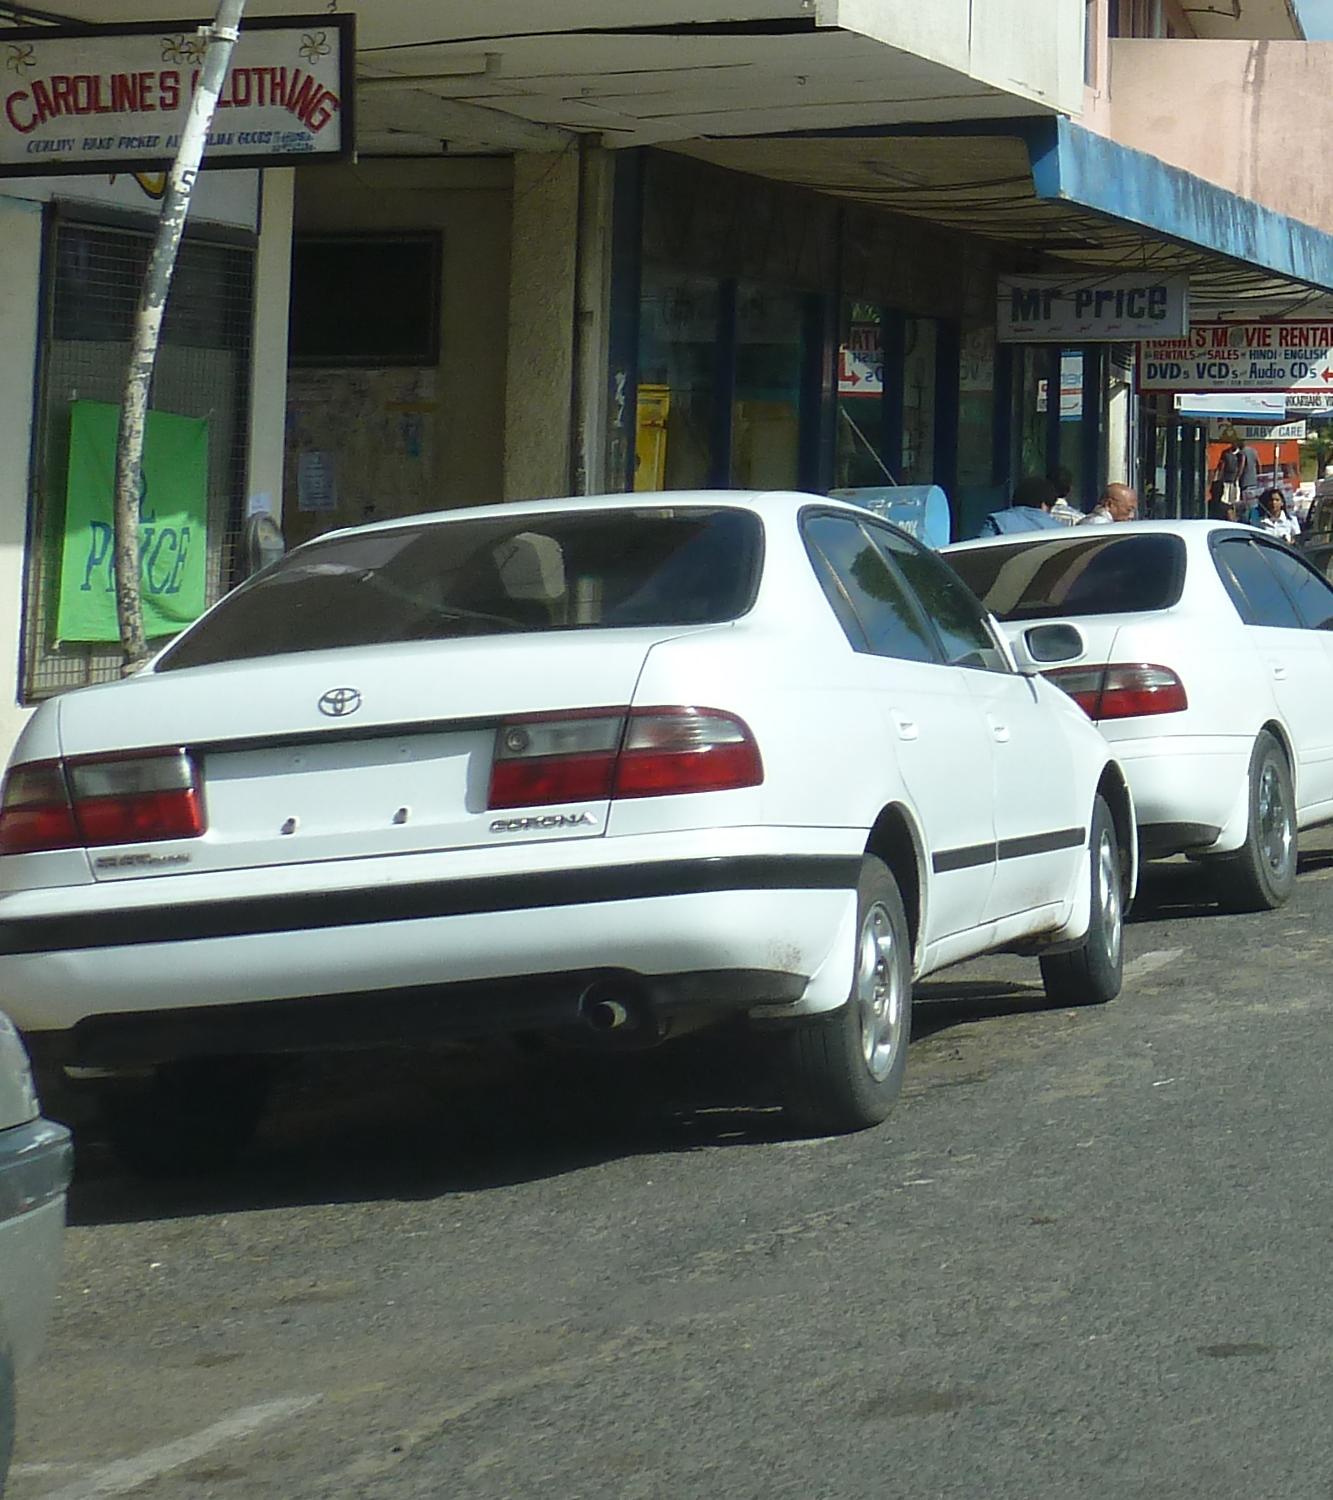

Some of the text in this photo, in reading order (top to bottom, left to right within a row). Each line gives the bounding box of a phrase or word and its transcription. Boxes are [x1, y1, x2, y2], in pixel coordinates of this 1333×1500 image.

[5, 70, 181, 134] CAROLINES
[1153, 349, 1196, 360] RENTALS
[1207, 349, 1239, 360] SALES
[1249, 349, 1277, 360] HINDI
[1284, 348, 1328, 360] ENGLISH
[1249, 361, 1286, 379] Audio
[1245, 426, 1303, 438] BABY CARE
